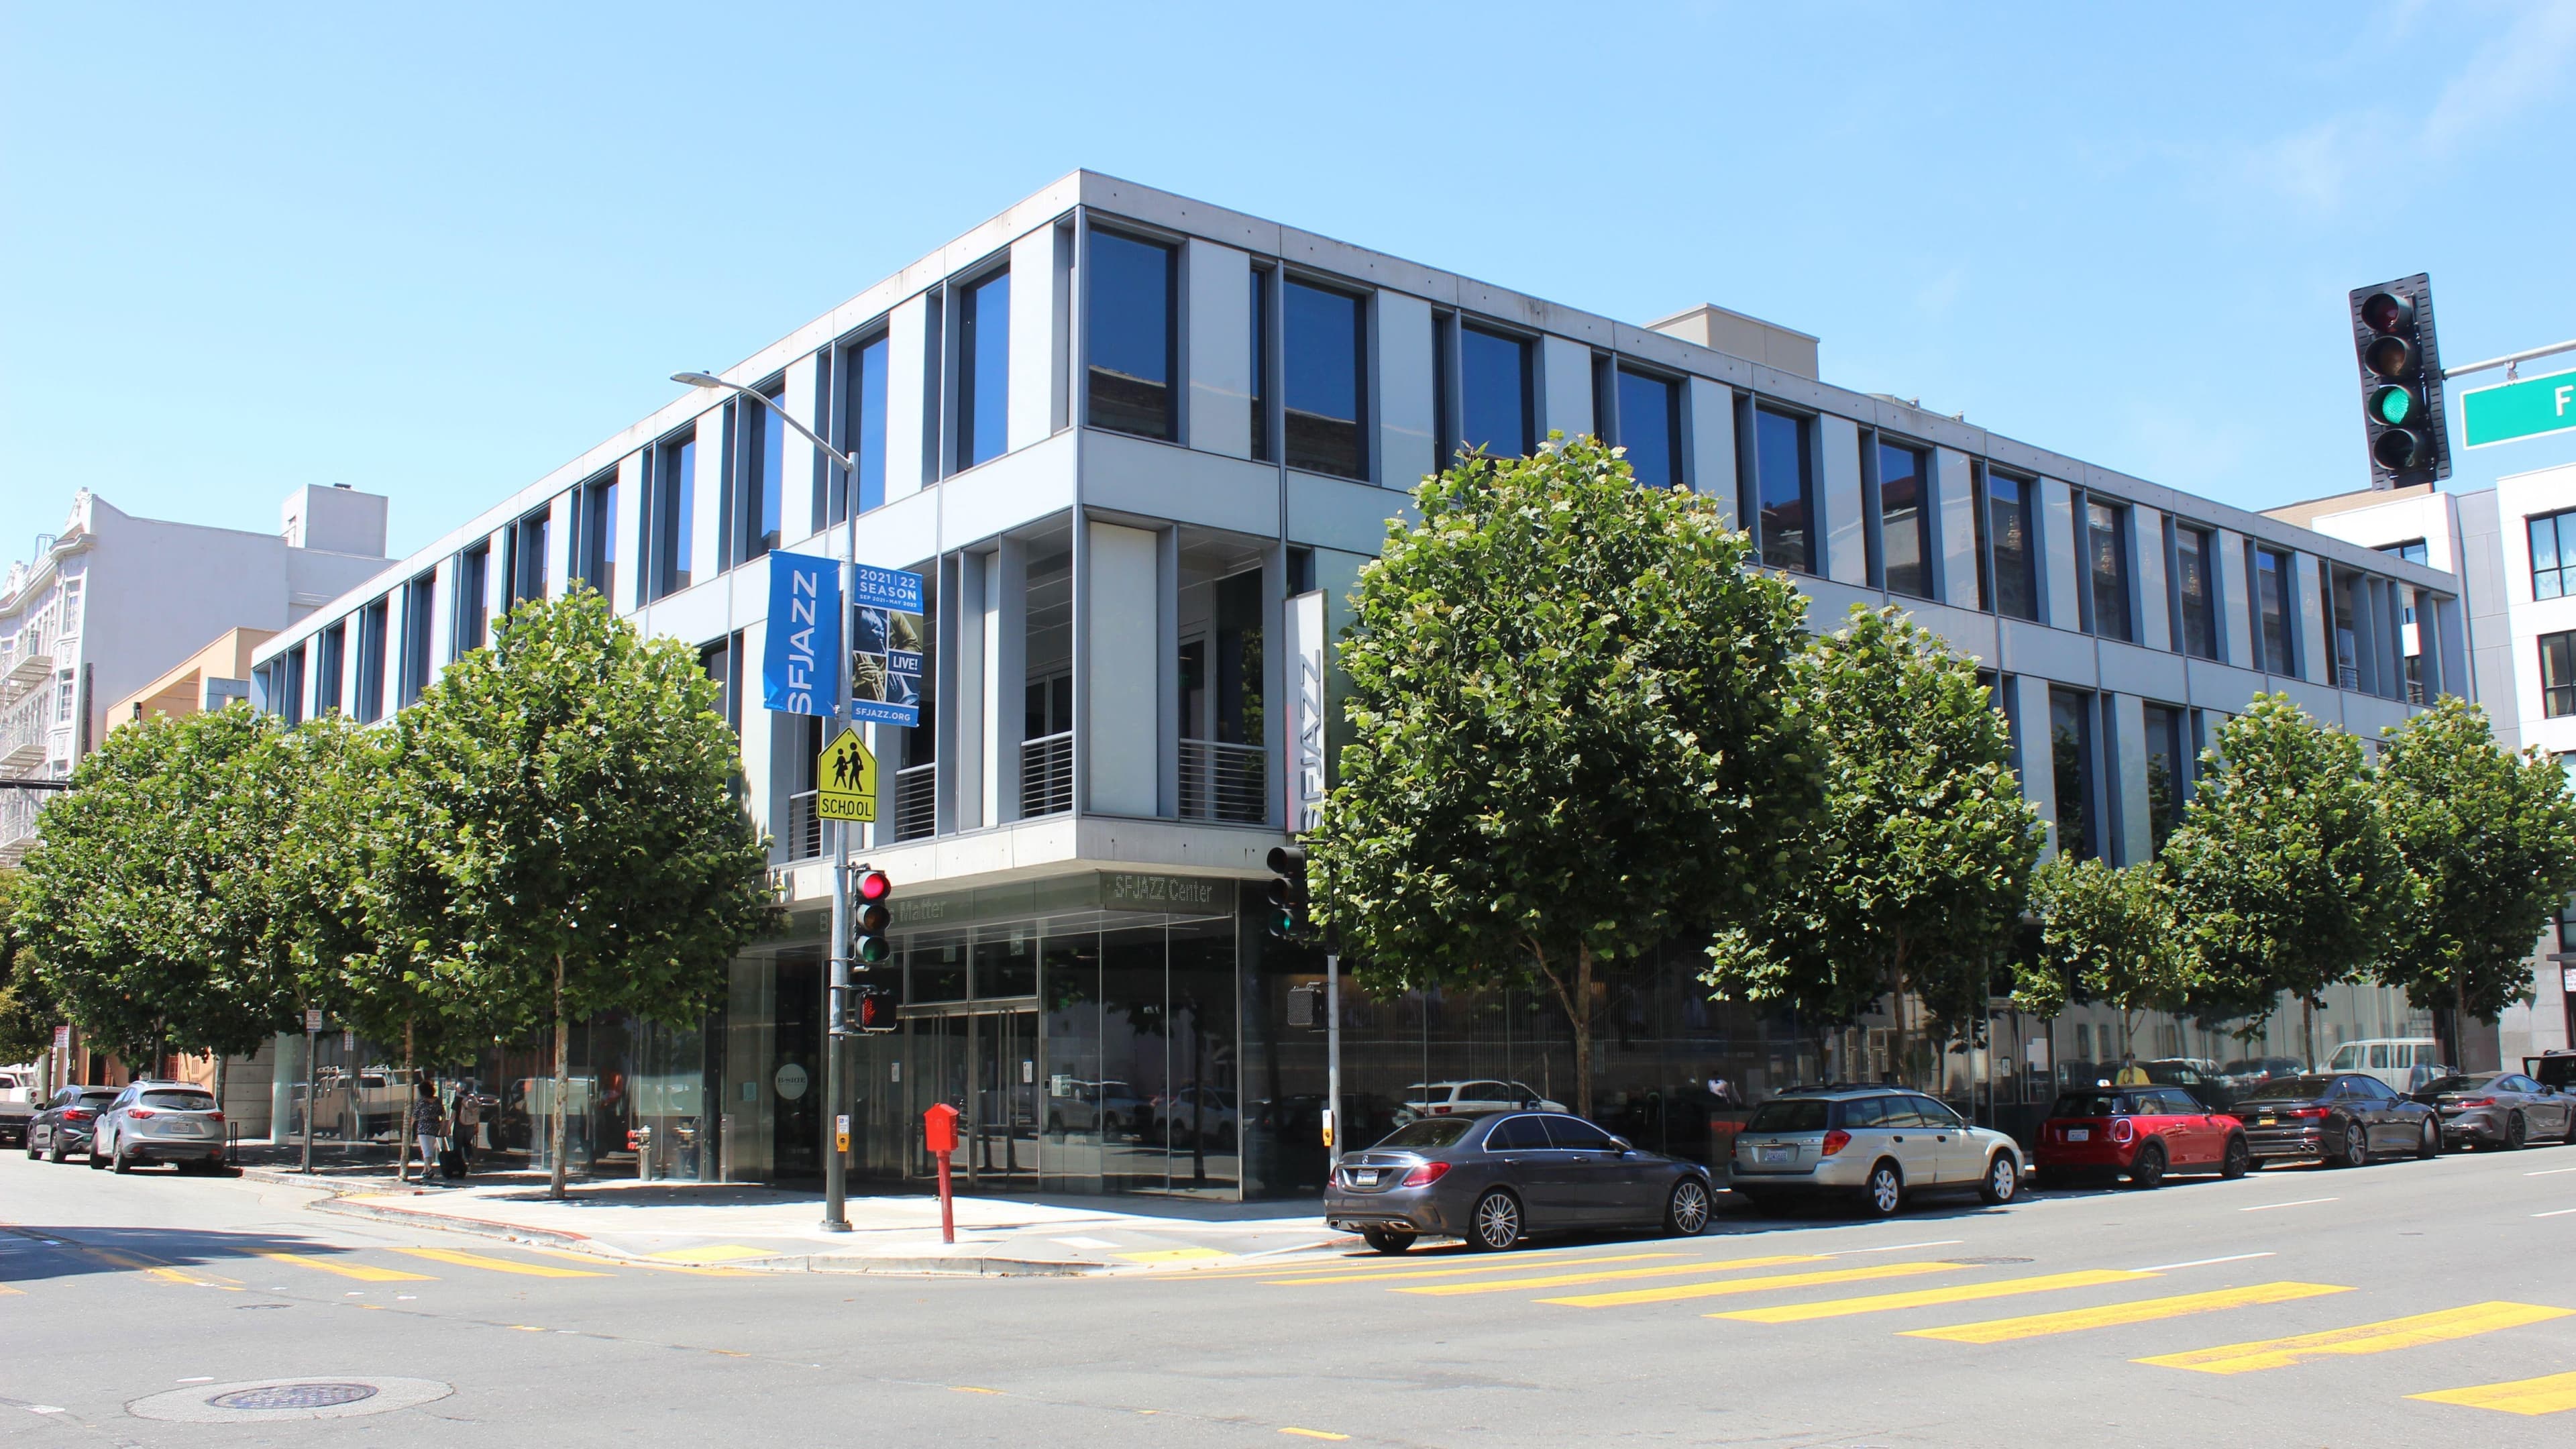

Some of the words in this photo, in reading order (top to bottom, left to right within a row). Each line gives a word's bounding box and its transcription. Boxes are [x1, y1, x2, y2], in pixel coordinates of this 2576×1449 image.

[860, 569, 891, 584] 2021
[901, 577, 916, 588] 22
[860, 582, 916, 600] SEASON
[788, 570, 818, 716] SFJAZZ
[892, 655, 918, 671] LIVE!
[855, 707, 911, 722] SFJAZZ.ORG
[1299, 649, 1322, 833] SFJAZZ
[822, 798, 872, 816] SCHOOL
[1114, 875, 1165, 900] SFJAZZ
[1169, 877, 1212, 902] Center
[899, 896, 947, 922] Matter
